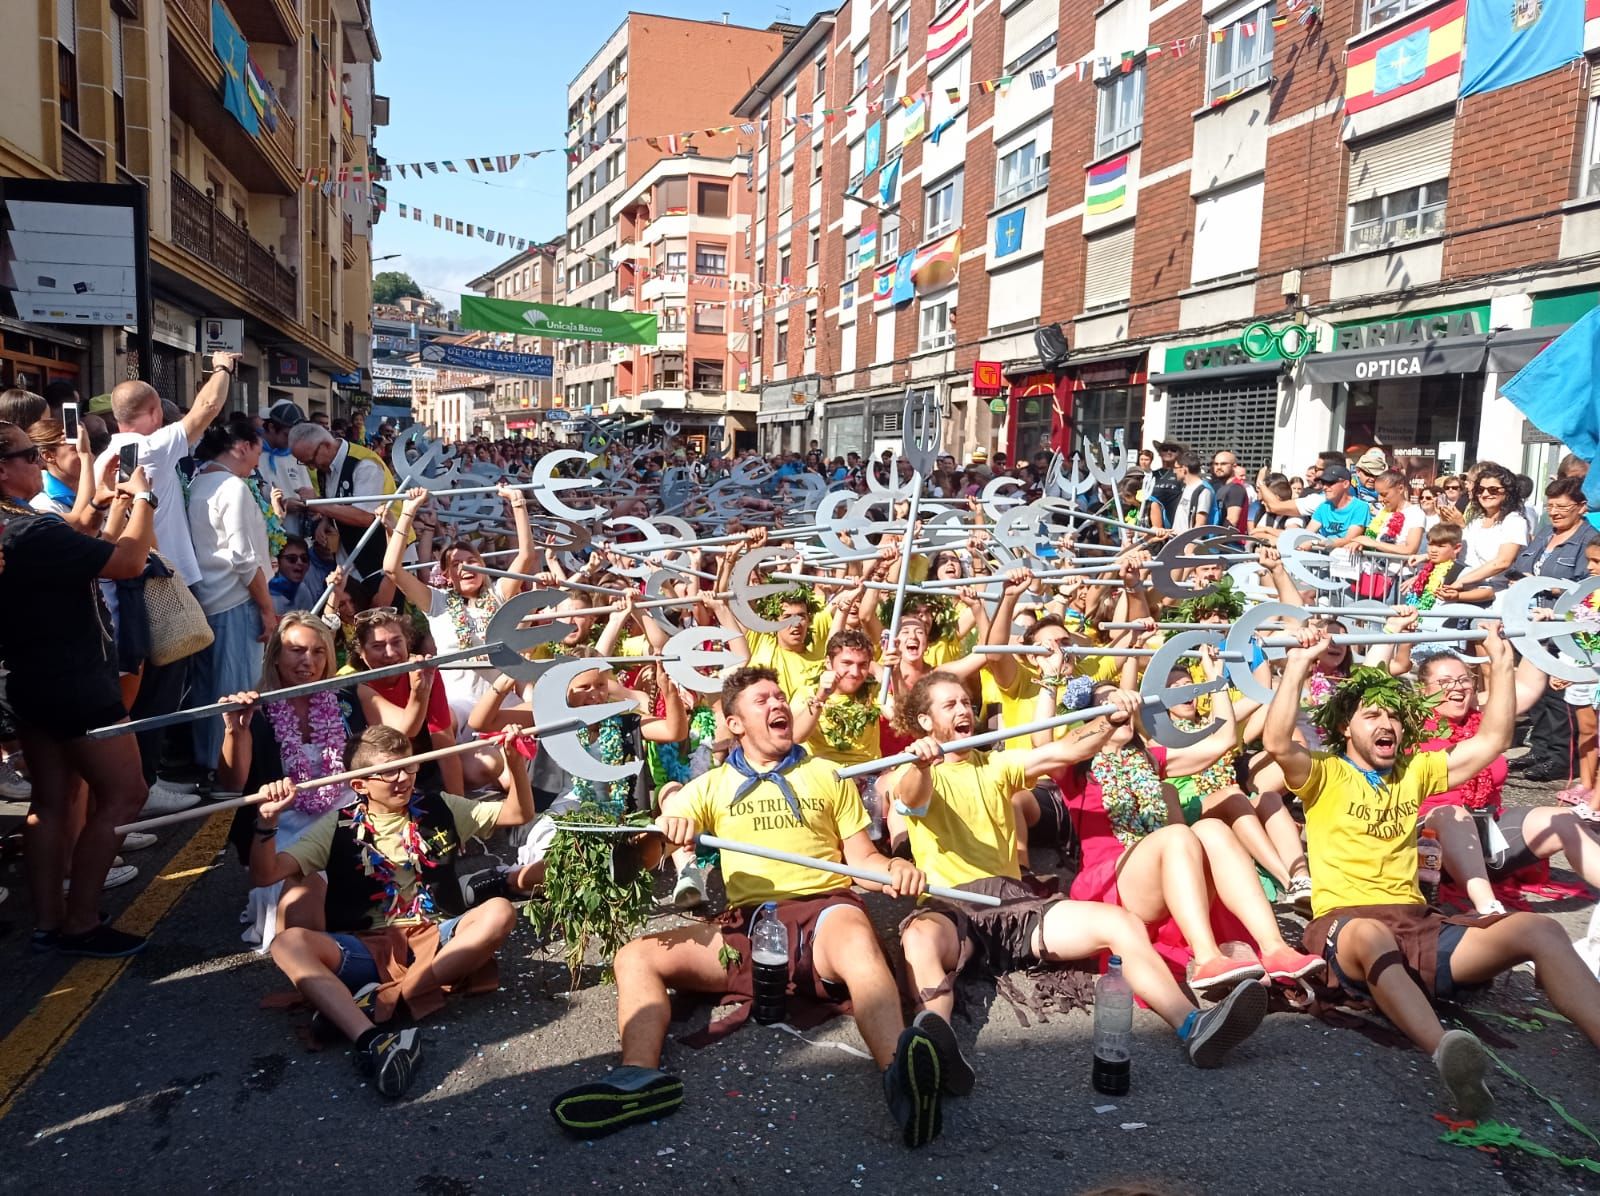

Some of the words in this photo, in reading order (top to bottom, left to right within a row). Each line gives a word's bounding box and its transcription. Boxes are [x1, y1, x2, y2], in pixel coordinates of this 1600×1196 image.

[546, 321, 578, 332] Unicaja
[578, 324, 603, 333] Banco
[1336, 312, 1479, 350] FARMACIA
[447, 347, 493, 360] DEPORTE
[497, 354, 552, 366] ASTURIANO
[1355, 357, 1422, 379] OPTICA
[729, 801, 754, 817] LOS
[758, 798, 825, 814] TRITNES
[1346, 801, 1371, 821] LOS
